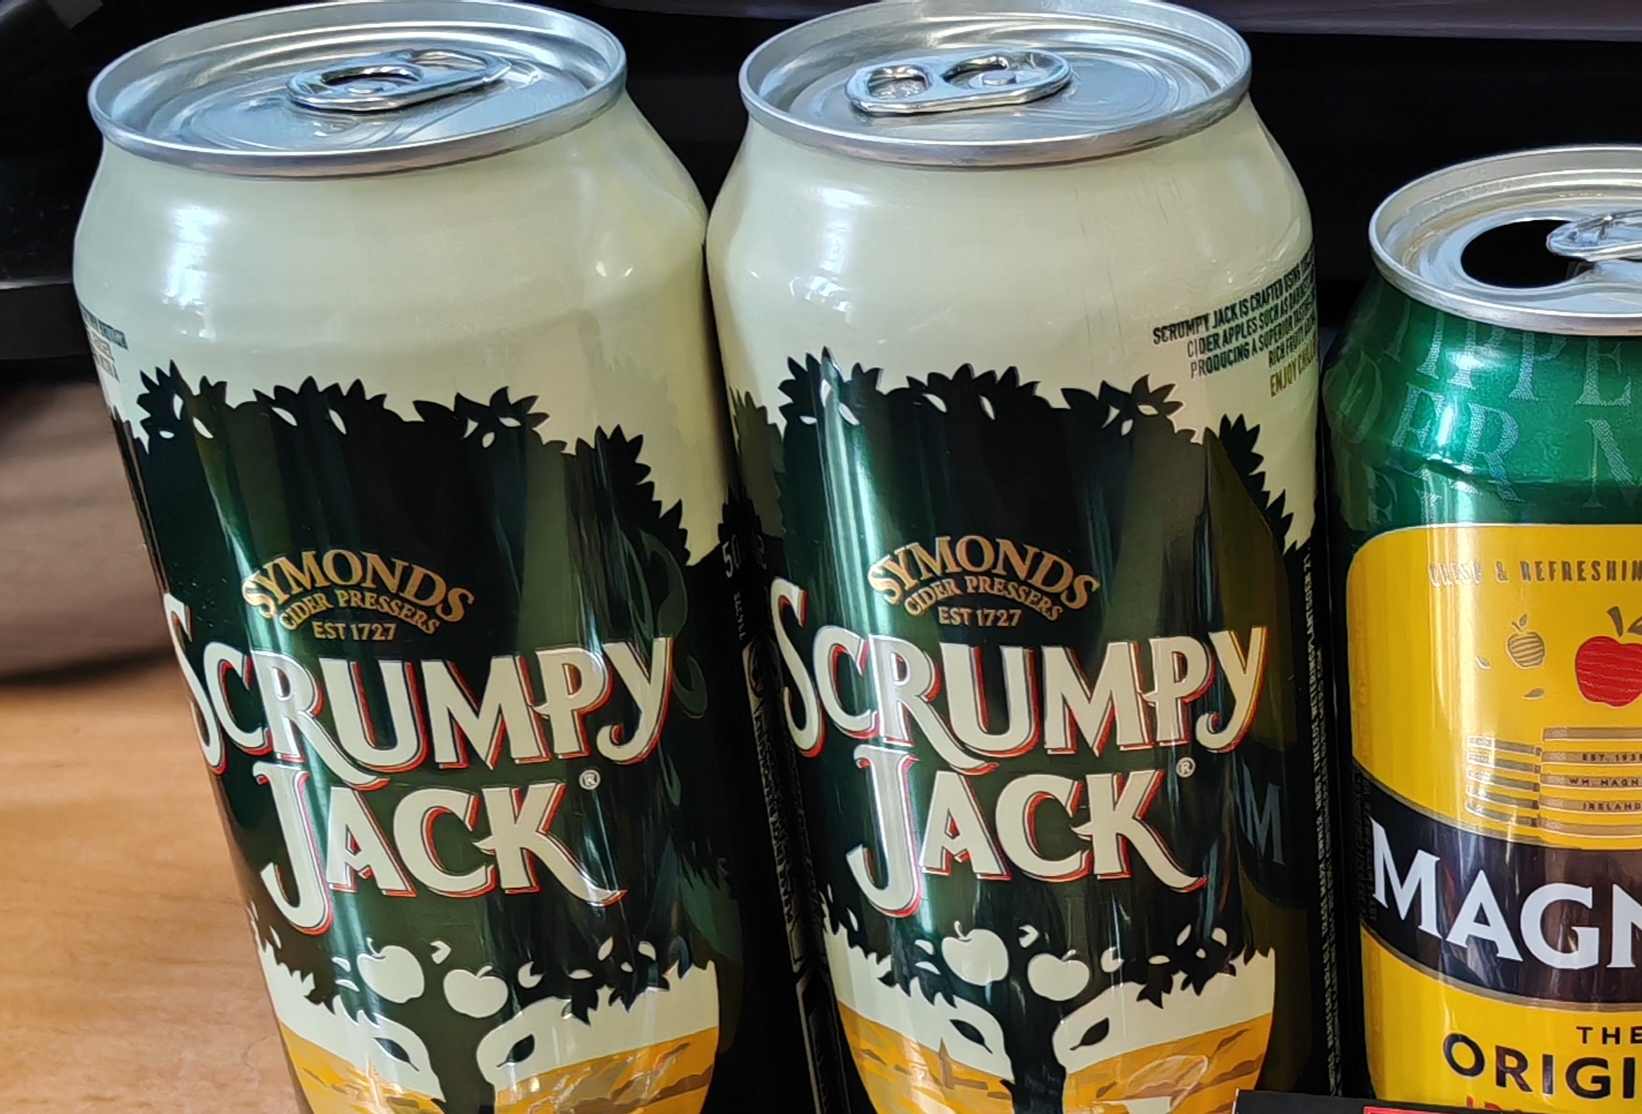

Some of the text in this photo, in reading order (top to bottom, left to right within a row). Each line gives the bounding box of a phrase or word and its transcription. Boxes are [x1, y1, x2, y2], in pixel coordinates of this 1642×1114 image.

[1152, 313, 1210, 345] SCRUMPY
[1212, 305, 1238, 329] JACK
[1240, 298, 1249, 317] IS
[1187, 333, 1220, 358] CIDER
[1222, 316, 1257, 347] APPLES
[1191, 343, 1250, 379] PRODUCING
[1270, 360, 1297, 397] ENJOY
[241, 549, 475, 623] SYMONDS
[868, 535, 1101, 610] SYMONDS
[279, 588, 441, 635] CIDER PRESSERS
[904, 575, 1064, 622] CIDER PRESSERS
[937, 606, 1023, 627] EST 1727
[312, 621, 398, 641] EST 1727
[161, 592, 675, 791] SCRUMPY
[770, 577, 1267, 776] SCRUMPY
[1582, 802, 1642, 811] IRELAND
[253, 762, 628, 936] JACK
[846, 745, 1208, 917] JACK
